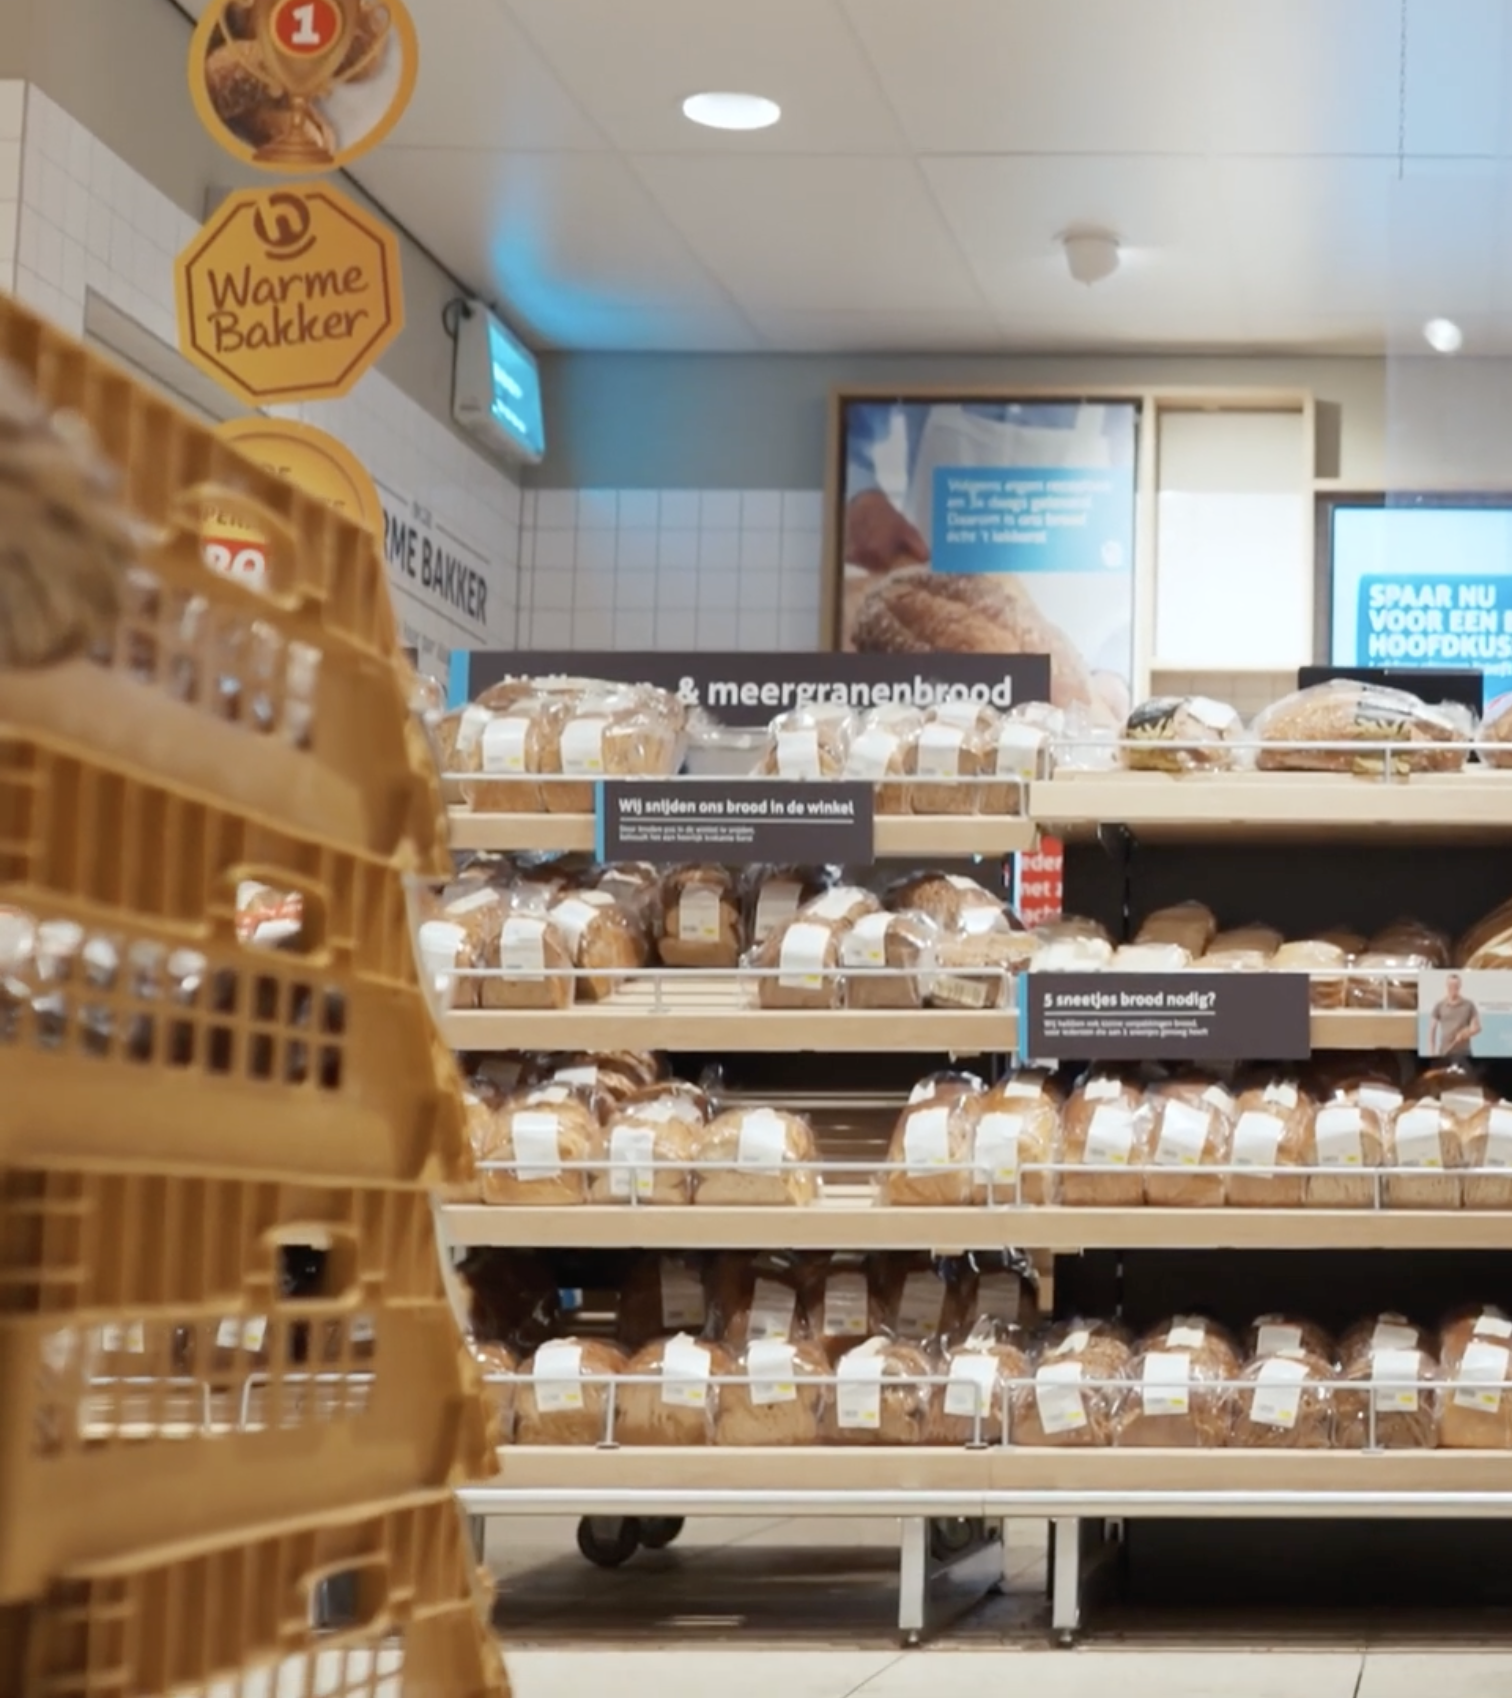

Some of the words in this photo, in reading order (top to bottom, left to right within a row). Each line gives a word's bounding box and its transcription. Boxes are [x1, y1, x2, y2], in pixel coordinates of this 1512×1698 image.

[291, 3, 320, 45] 1
[207, 264, 369, 308] Warme
[207, 301, 369, 352] Bakker
[421, 535, 489, 627] BAKKER
[1369, 584, 1452, 608] SPAAR
[1458, 584, 1496, 608] NU
[1369, 609, 1444, 633] VOOR
[1449, 610, 1498, 633] EEN
[677, 677, 699, 705] &
[707, 675, 1012, 709] meergranenbrood
[618, 798, 642, 815] Wij
[645, 798, 696, 815] snijden
[699, 801, 724, 814] ons
[726, 799, 768, 815] brood
[770, 799, 785, 814] in
[787, 800, 805, 815] de
[807, 800, 855, 816] winkel
[1043, 993, 1053, 1008] 5
[1057, 991, 1117, 1009] sneetjes
[1120, 992, 1164, 1006] brood
[1166, 992, 1216, 1009] nodig?
